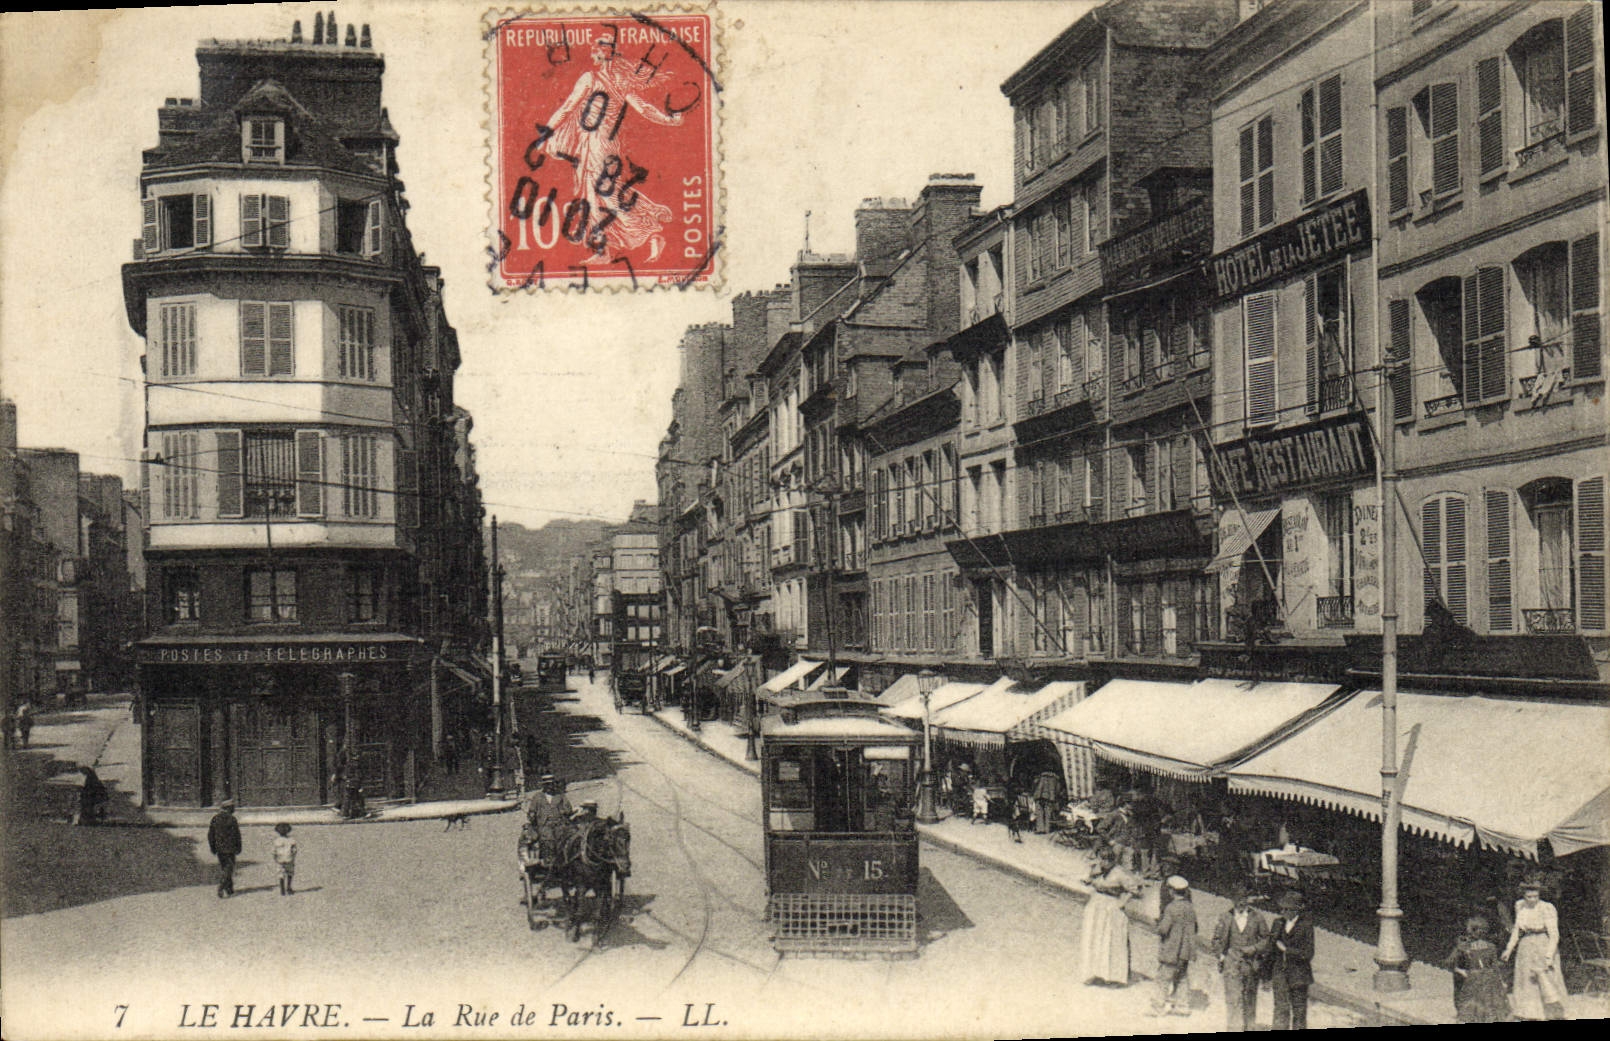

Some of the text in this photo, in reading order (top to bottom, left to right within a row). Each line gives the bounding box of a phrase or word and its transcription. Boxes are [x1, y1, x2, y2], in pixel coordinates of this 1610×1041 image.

[684, 175, 702, 258] POSTES
[1214, 242, 1271, 296] HOTEL
[1251, 422, 1367, 493] RESTAURANT
[161, 648, 223, 661] POSTES
[266, 646, 388, 662] TELEGRAPHES
